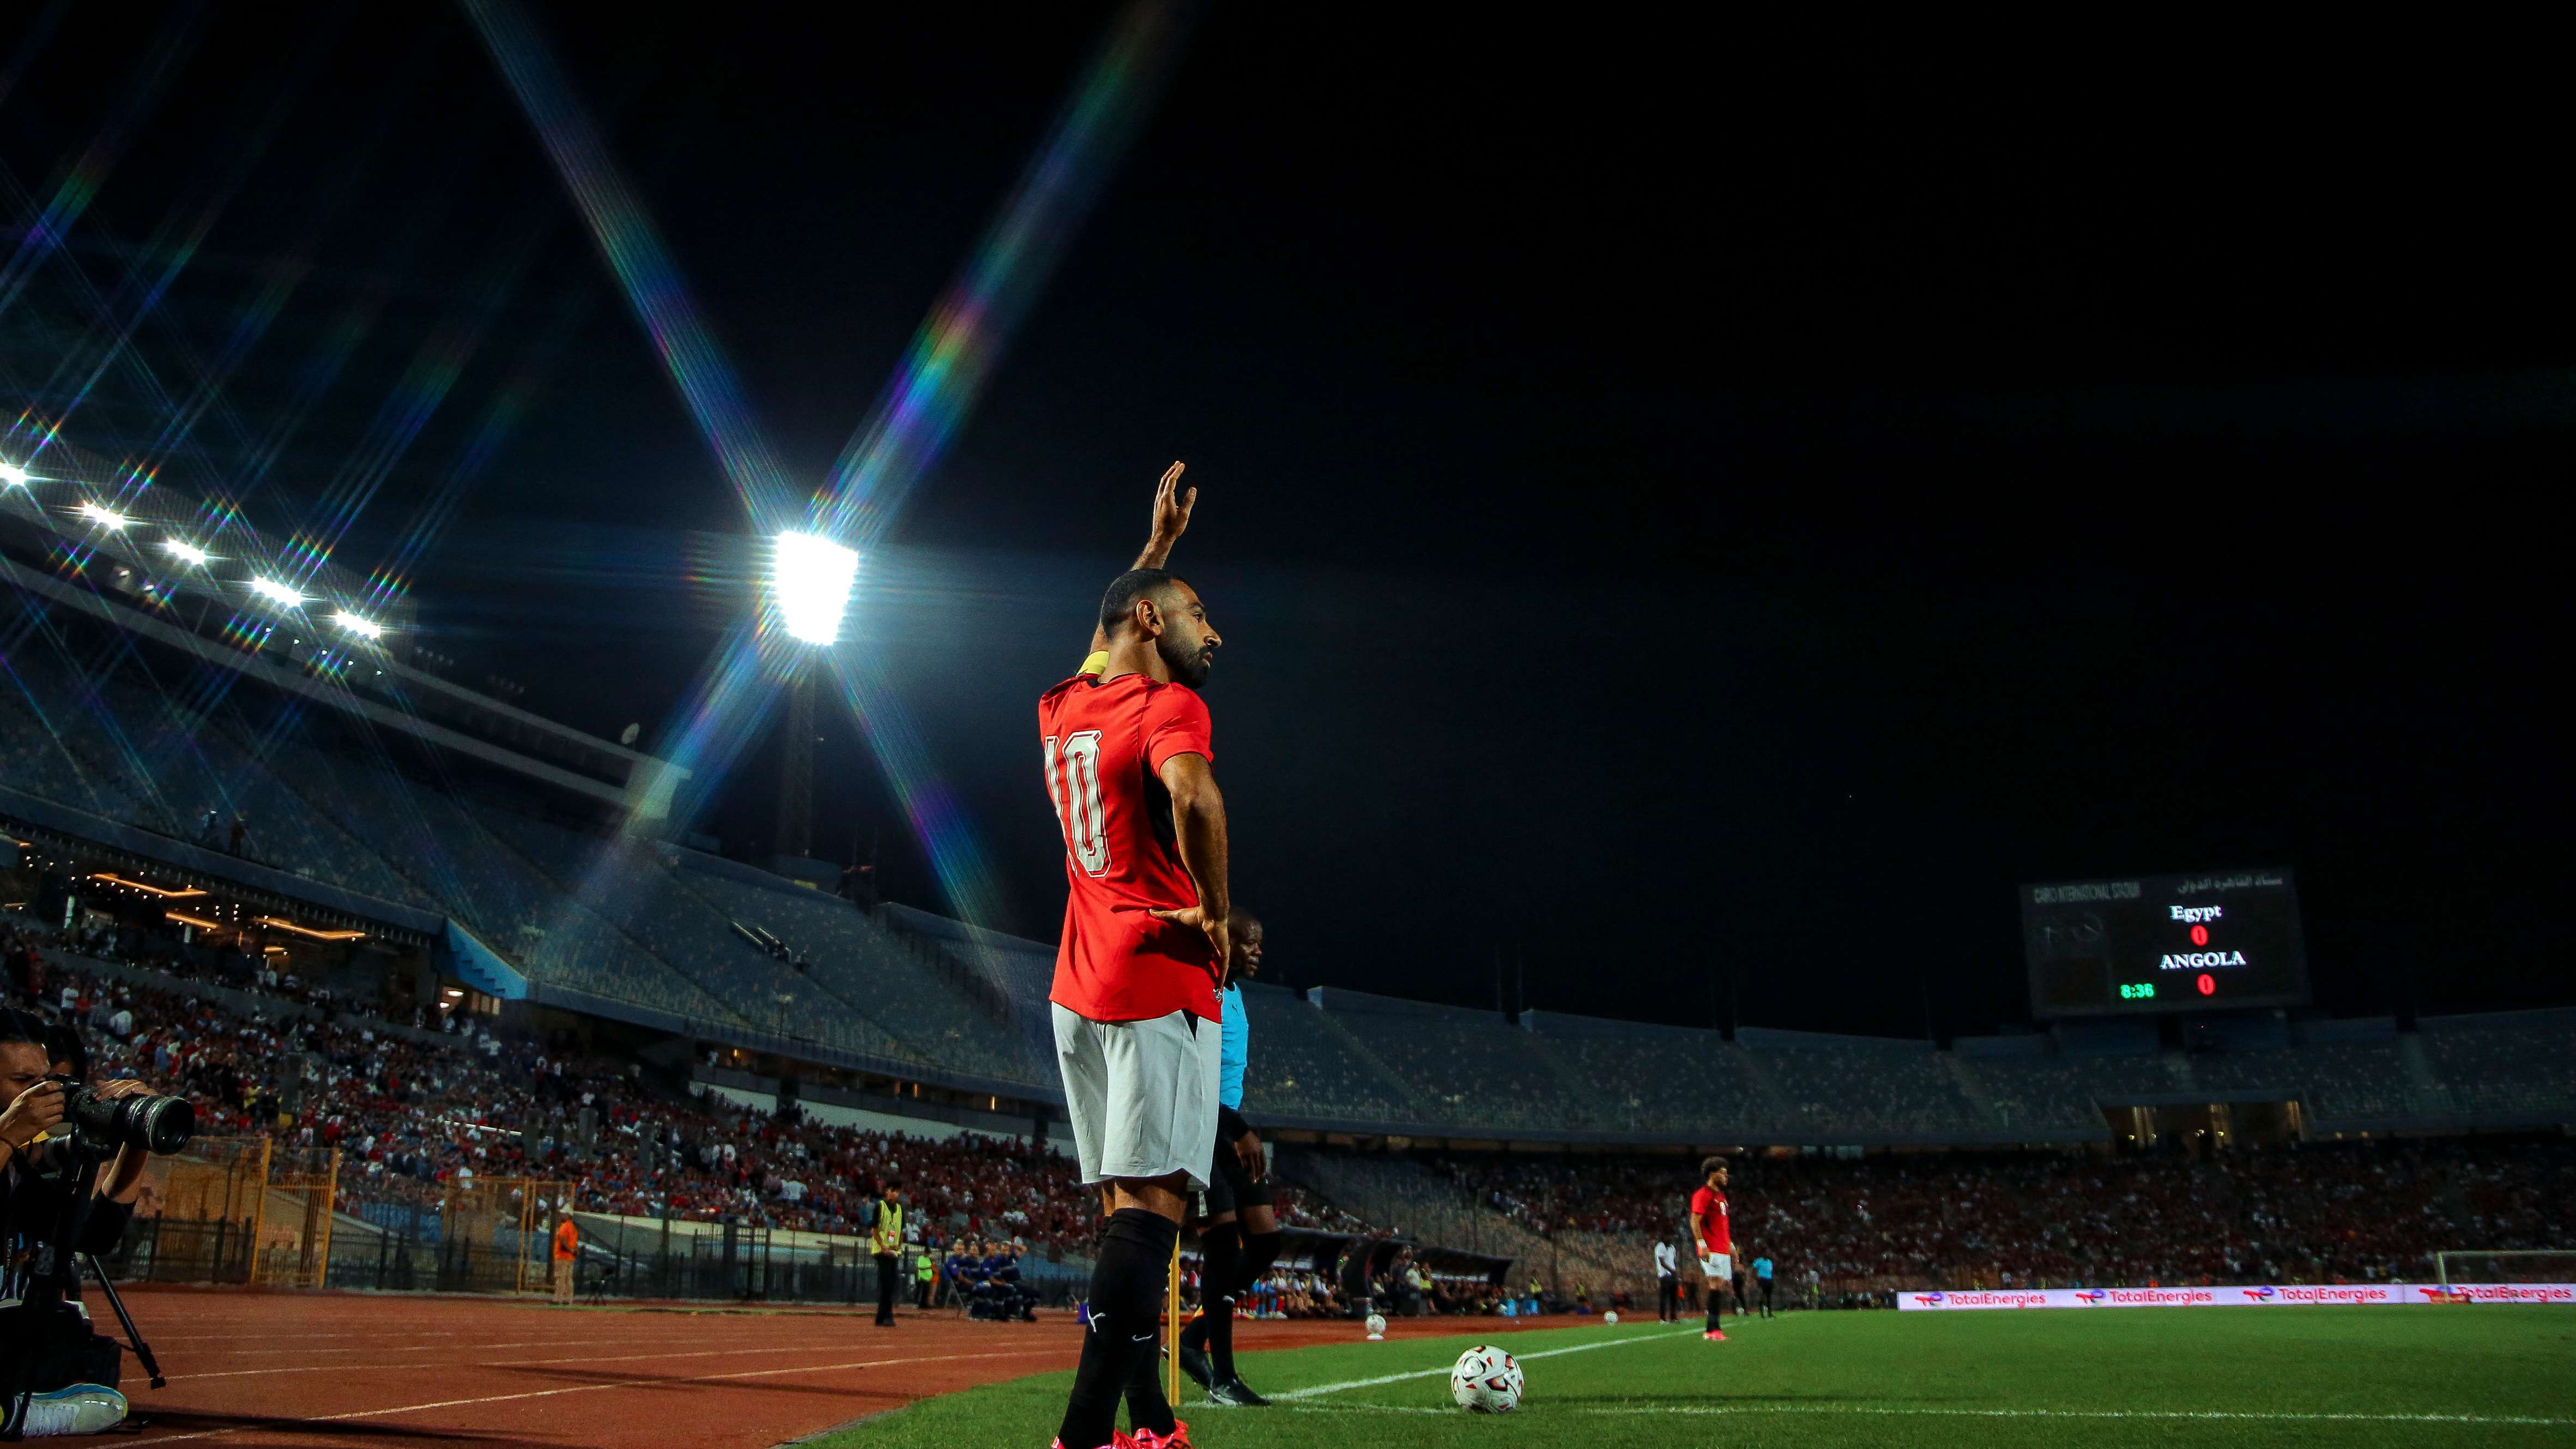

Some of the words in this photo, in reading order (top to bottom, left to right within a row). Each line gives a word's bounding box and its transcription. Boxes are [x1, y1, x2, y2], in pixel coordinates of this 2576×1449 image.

[1044, 729, 1111, 878] 10
[2169, 905, 2222, 922] Egypt
[2191, 925, 2208, 946] 0
[2159, 951, 2247, 970] ANGOLA
[2120, 983, 2155, 999] 8:36
[2197, 974, 2215, 995] 0
[1948, 1291, 2046, 1308] TotalEnergies
[2109, 1289, 2213, 1305] TotalEnergies
[2278, 1287, 2387, 1304] TotalEnergies
[2457, 1285, 2572, 1303] TotalEnergies
